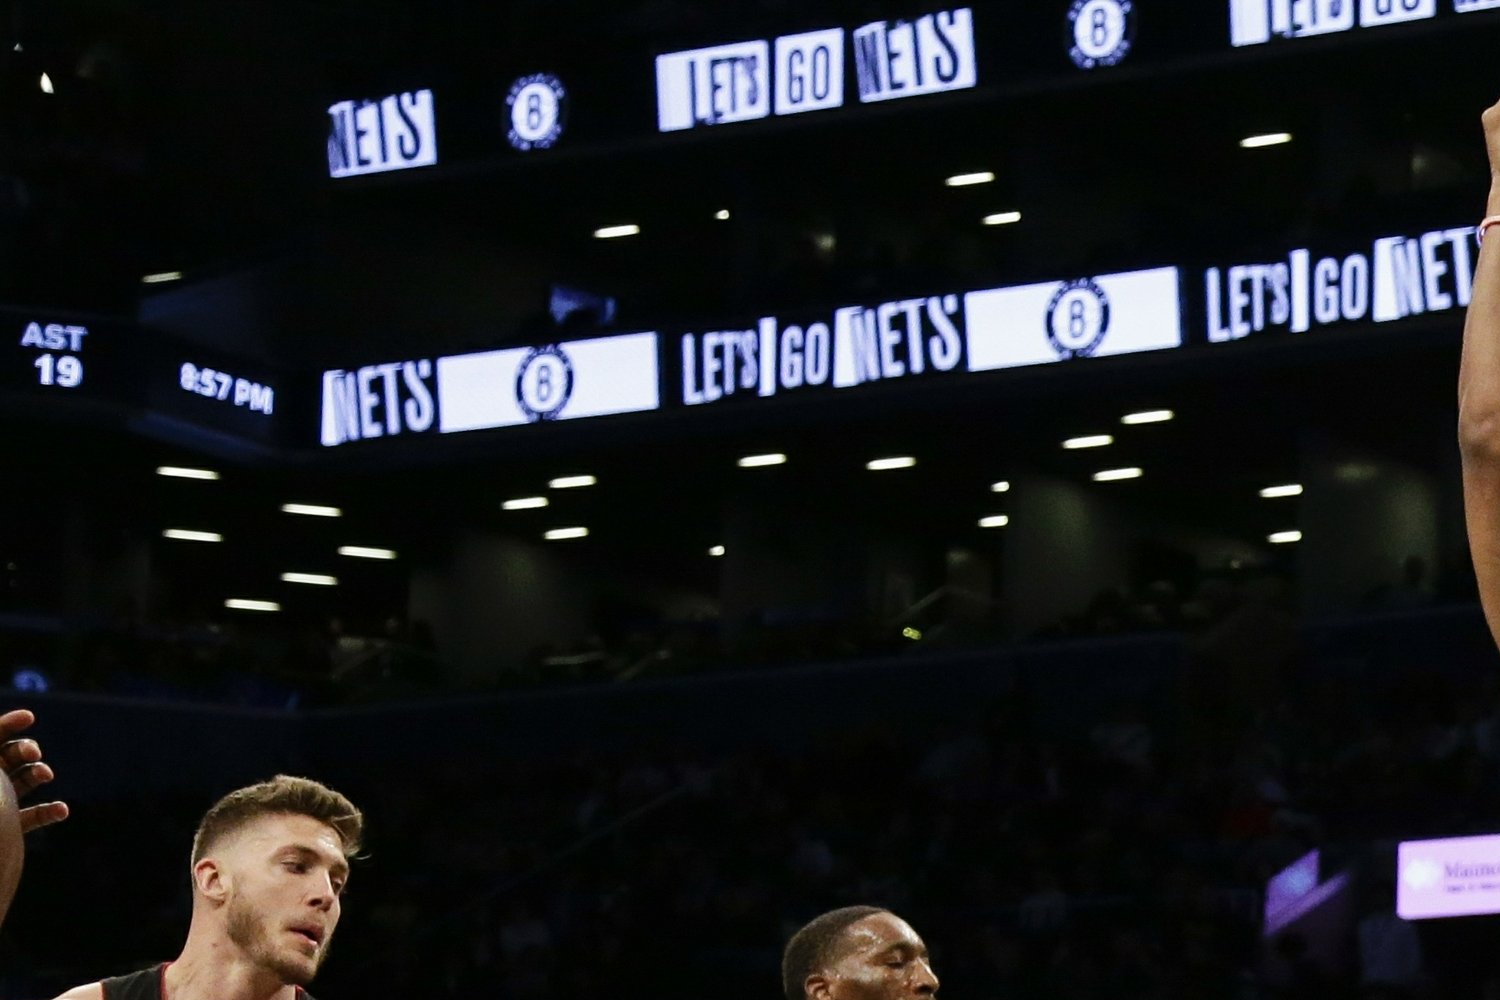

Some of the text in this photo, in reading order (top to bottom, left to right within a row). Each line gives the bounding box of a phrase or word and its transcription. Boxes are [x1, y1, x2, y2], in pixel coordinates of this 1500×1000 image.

[789, 45, 829, 104] GO
[1313, 253, 1369, 323] GO
[1373, 225, 1480, 322] NET
[20, 321, 88, 351] AST
[780, 321, 830, 389] GO
[833, 293, 962, 388] NETS
[34, 353, 83, 388] 19
[234, 377, 274, 414] PM
[321, 358, 433, 447] NETS
